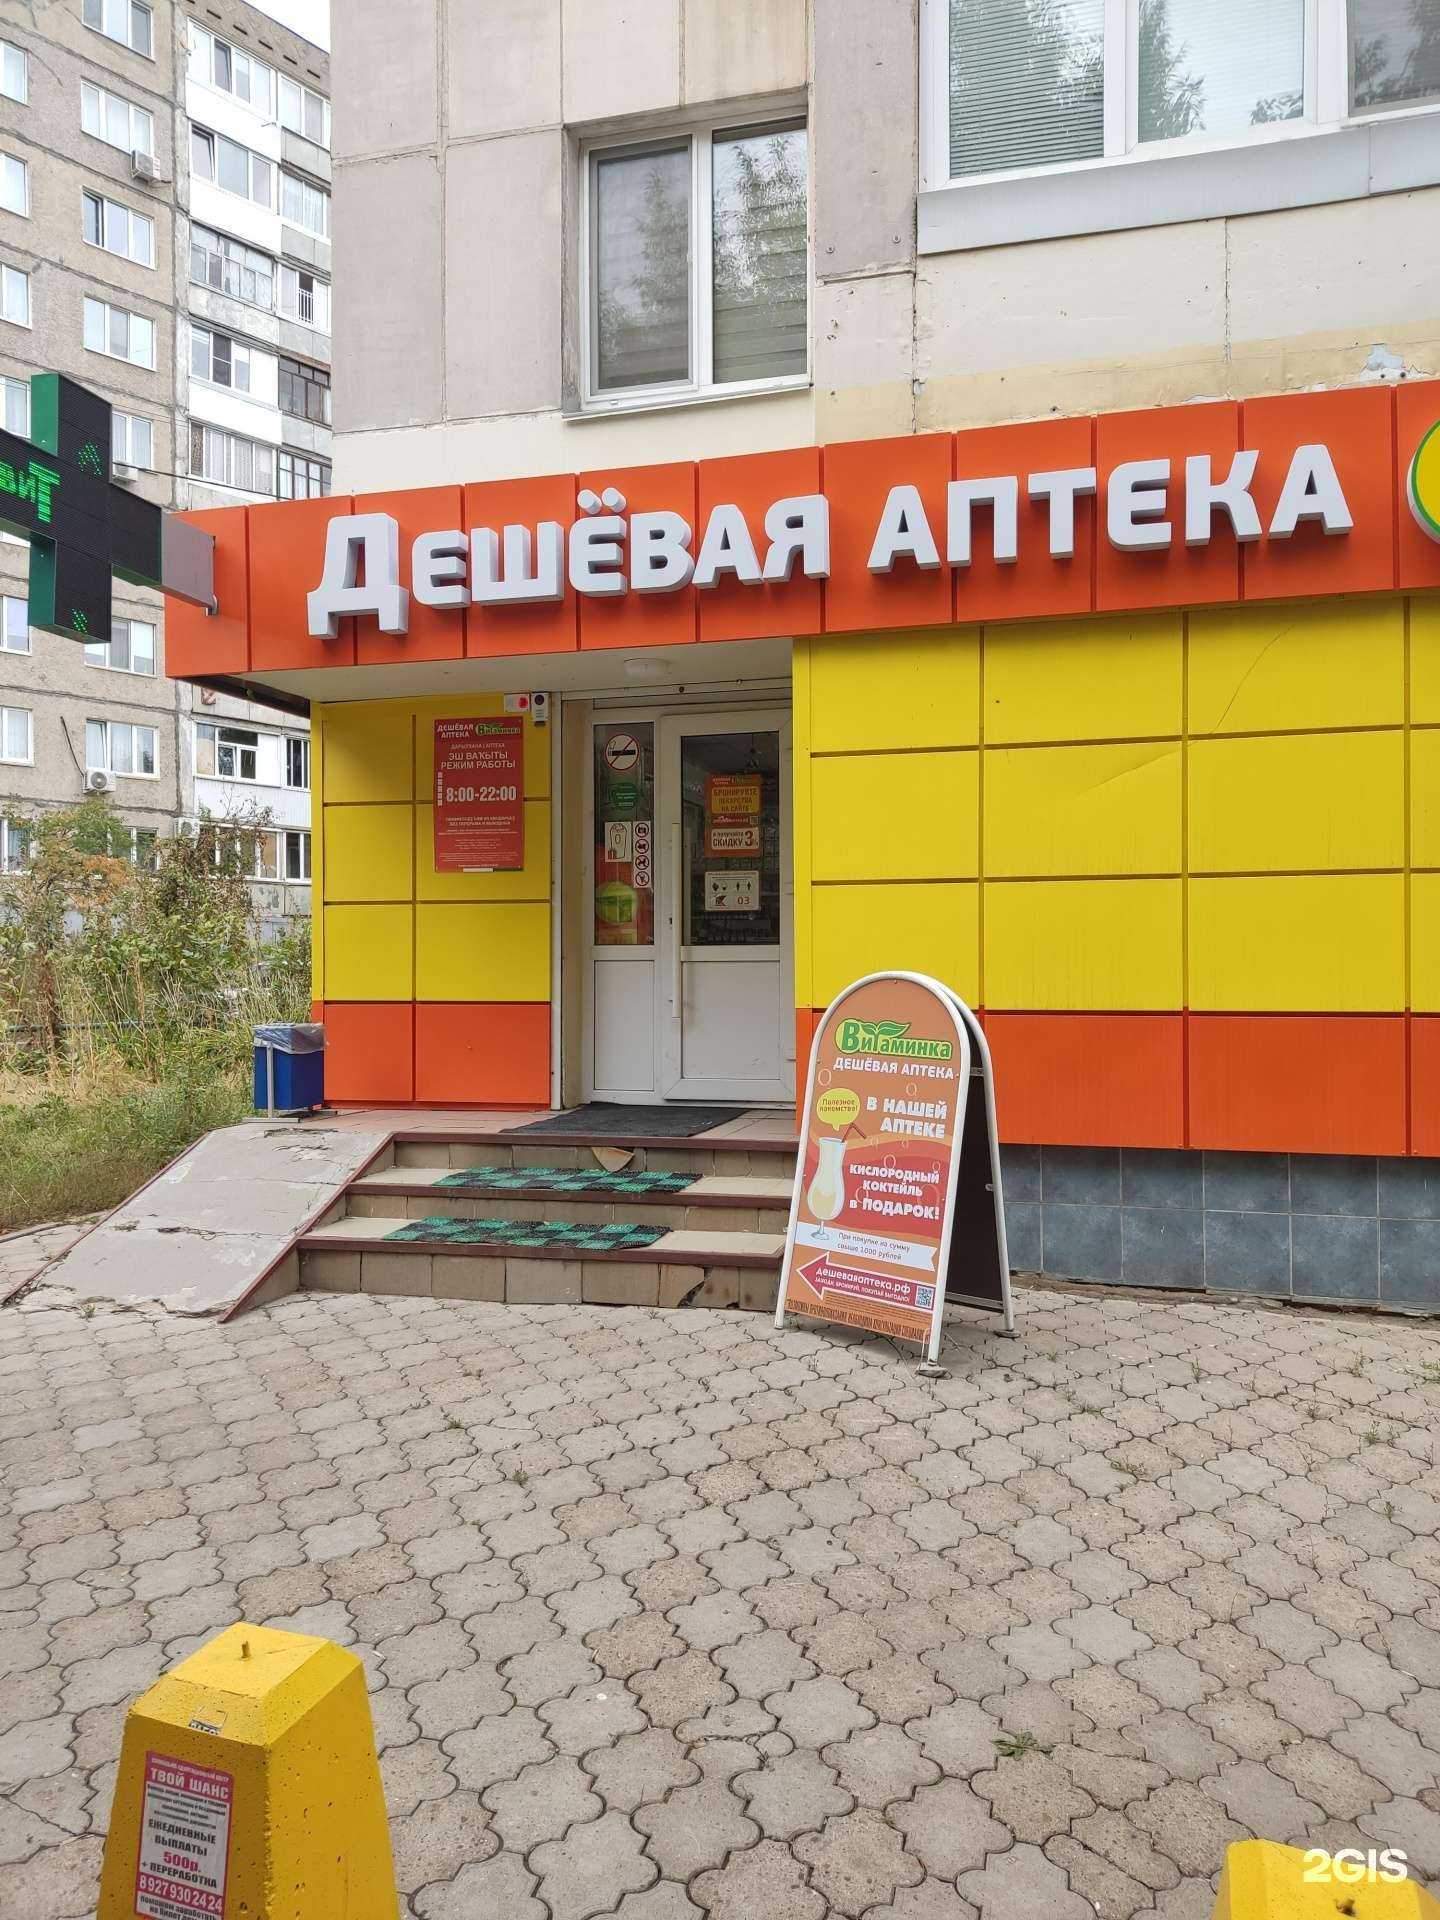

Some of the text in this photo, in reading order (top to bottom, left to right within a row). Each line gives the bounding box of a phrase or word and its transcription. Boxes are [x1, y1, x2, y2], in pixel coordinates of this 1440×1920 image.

[307, 444, 1354, 640] ДЕШЁВАЯ АПТЕКА
[441, 731, 470, 739] АПТЕКА
[441, 760, 516, 770] РЕЖИМ РАБОТЫ
[448, 752, 464, 761] ЭШ
[446, 786, 517, 802] 8:00-22:00
[712, 838, 743, 847] СКИДКУ
[737, 896, 751, 905] 03
[841, 1020, 950, 1059] Витаминка
[833, 1057, 954, 1080] ДЕШЁВАЯ АПТЕКА
[822, 1098, 855, 1106] Полезное
[866, 1096, 947, 1119] В НАШЕЙ
[880, 1117, 945, 1139] АПТЕКЕ
[849, 1163, 940, 1184] КИСЛОРОДНЫЙ
[862, 1180, 923, 1196] КОКТЕЙЛЬ
[862, 1197, 940, 1220] ПОДАРОК!
[838, 1232, 851, 1242] При
[859, 1246, 877, 1256] 1000
[878, 1250, 902, 1261] рублей
[815, 1267, 911, 1296] дешеваяаптека.рф
[151, 1767, 185, 1788] ТВОЙ
[189, 1778, 229, 1800] ШАНС
[148, 1818, 216, 1845] ЕЖЕДНЕВНЫЕ
[154, 1834, 208, 1857] ВЫПЛАТЫ
[150, 1862, 217, 1888] ПЕРЕРАБОТКА
